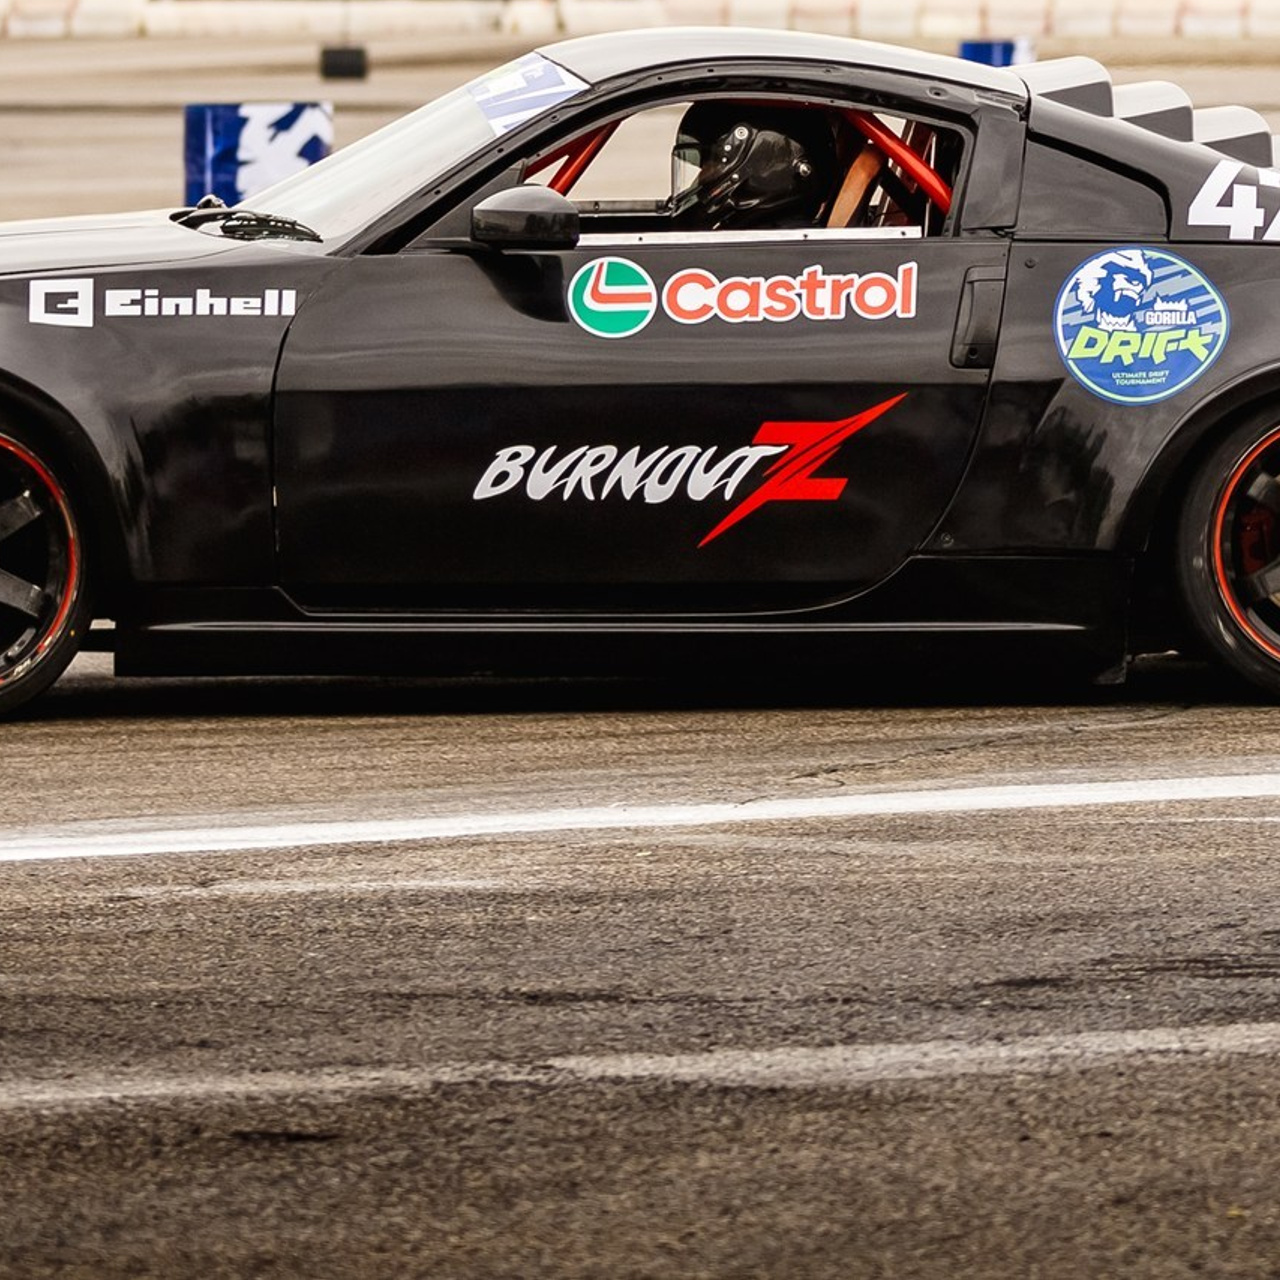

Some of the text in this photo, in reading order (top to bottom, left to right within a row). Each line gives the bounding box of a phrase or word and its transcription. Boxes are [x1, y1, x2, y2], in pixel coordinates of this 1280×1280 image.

[105, 289, 296, 316] Einhell
[663, 262, 917, 323] Castrol
[1145, 311, 1197, 326] GORILLA
[1067, 326, 1214, 366] DRIFT
[1111, 370, 1170, 379] ULTIMATE DRIFT
[1116, 377, 1167, 386] TOURNAMENT
